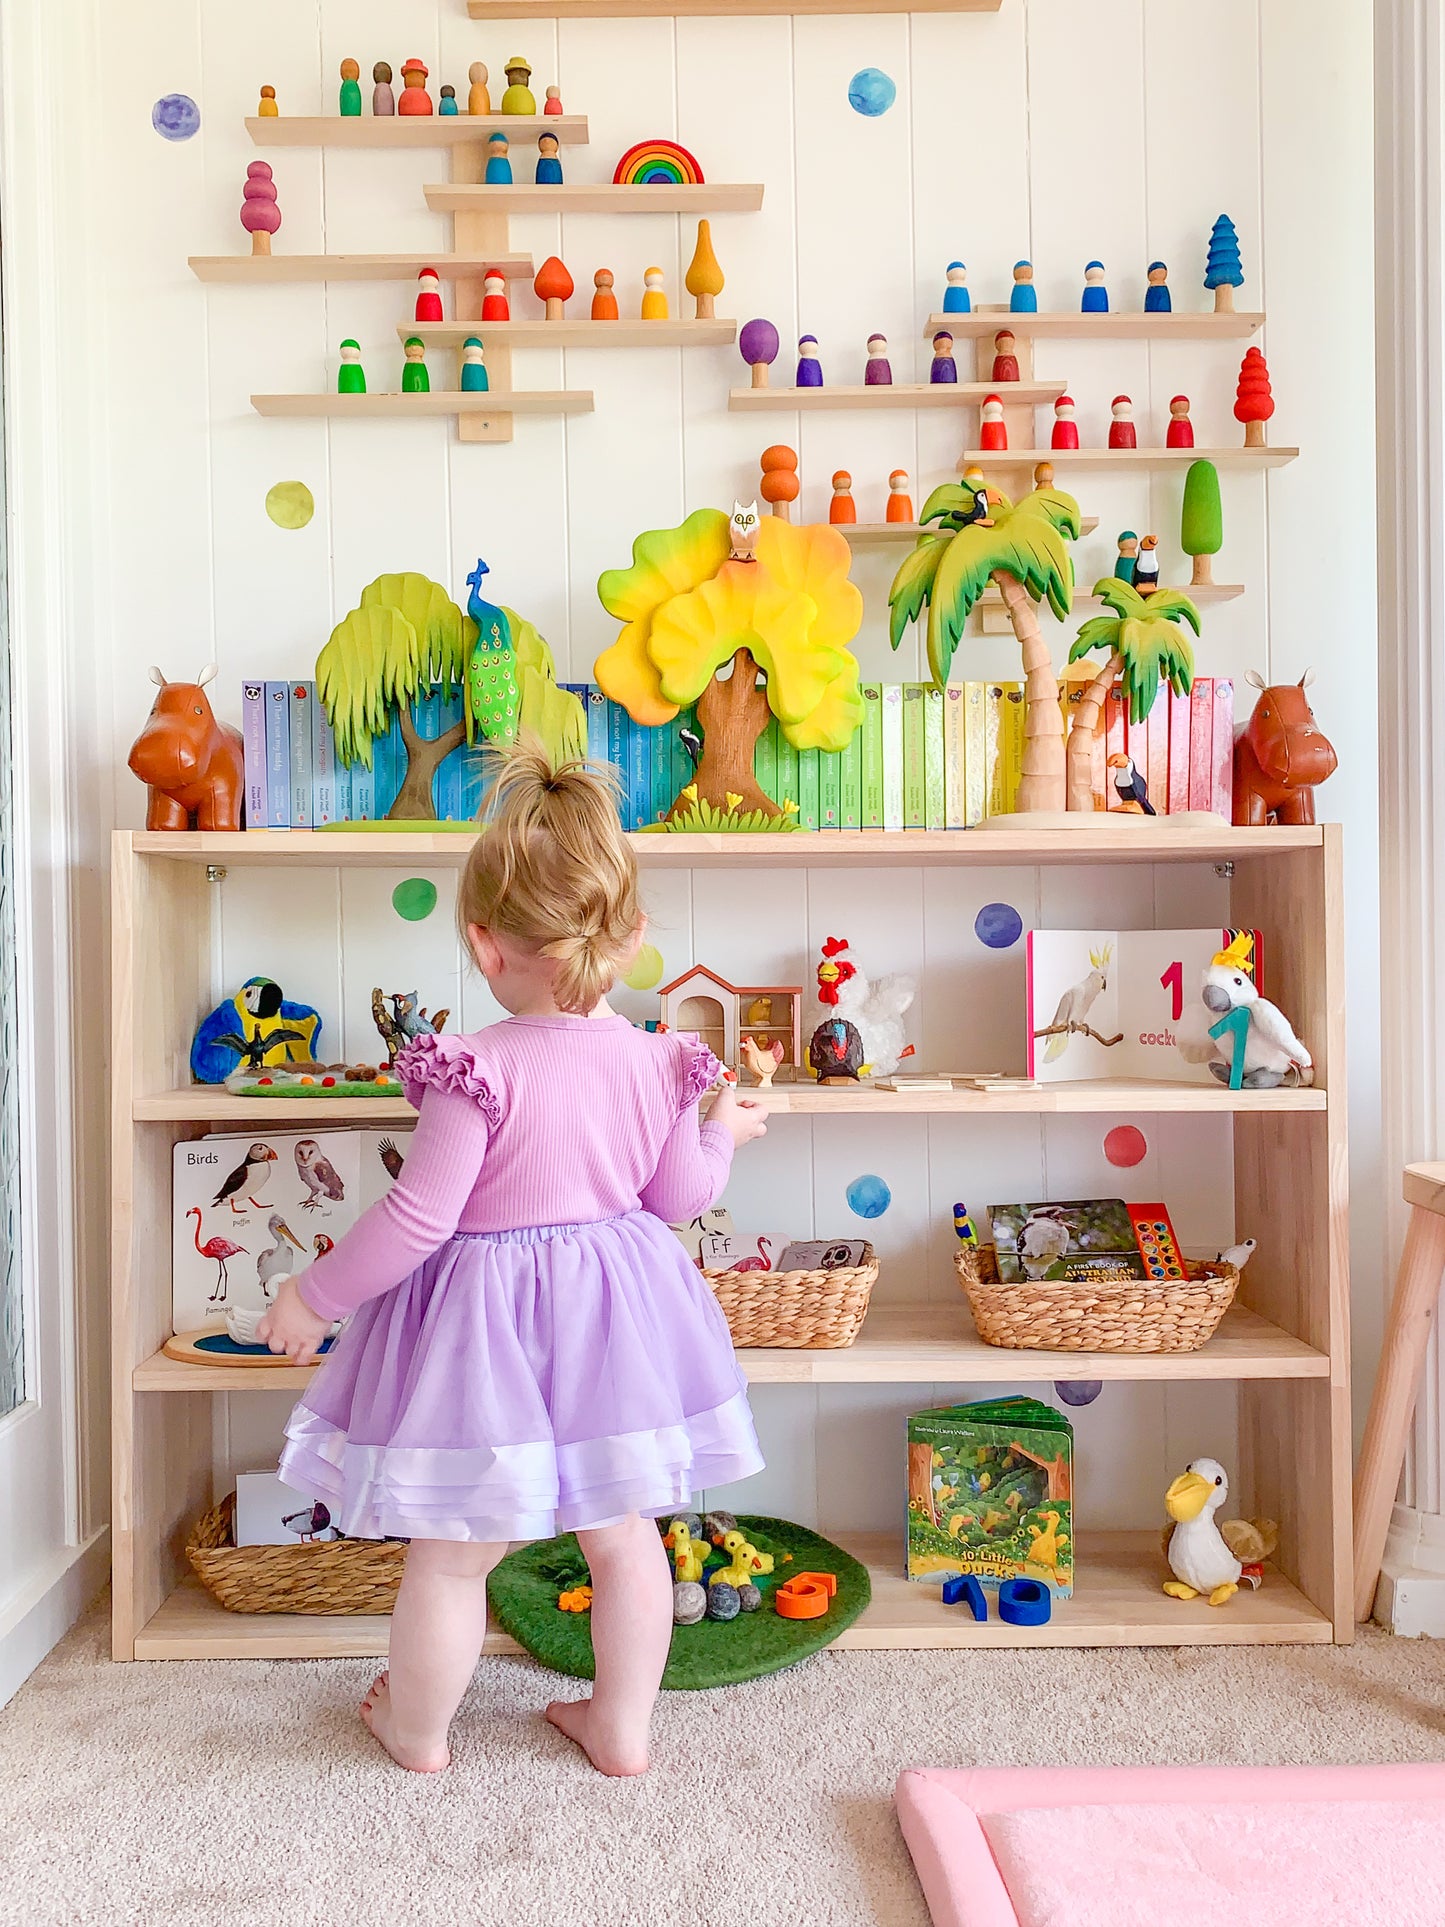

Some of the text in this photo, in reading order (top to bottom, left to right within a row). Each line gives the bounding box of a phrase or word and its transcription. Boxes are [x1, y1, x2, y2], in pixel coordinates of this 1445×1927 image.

[614, 706, 622, 726] That's
[319, 723, 327, 734] not
[614, 727, 622, 740] not
[612, 742, 622, 752] my
[635, 744, 644, 756] my
[656, 743, 665, 754] my
[1160, 961, 1183, 1021] 1
[187, 1152, 219, 1165] Birds
[232, 1217, 251, 1227] puffin
[1073, 1262, 1094, 1270] FIRST
[1064, 1267, 1136, 1278] AUSTRALIAN
[205, 1306, 233, 1317] flamingo
[961, 1550, 1014, 1567] 10 Little
